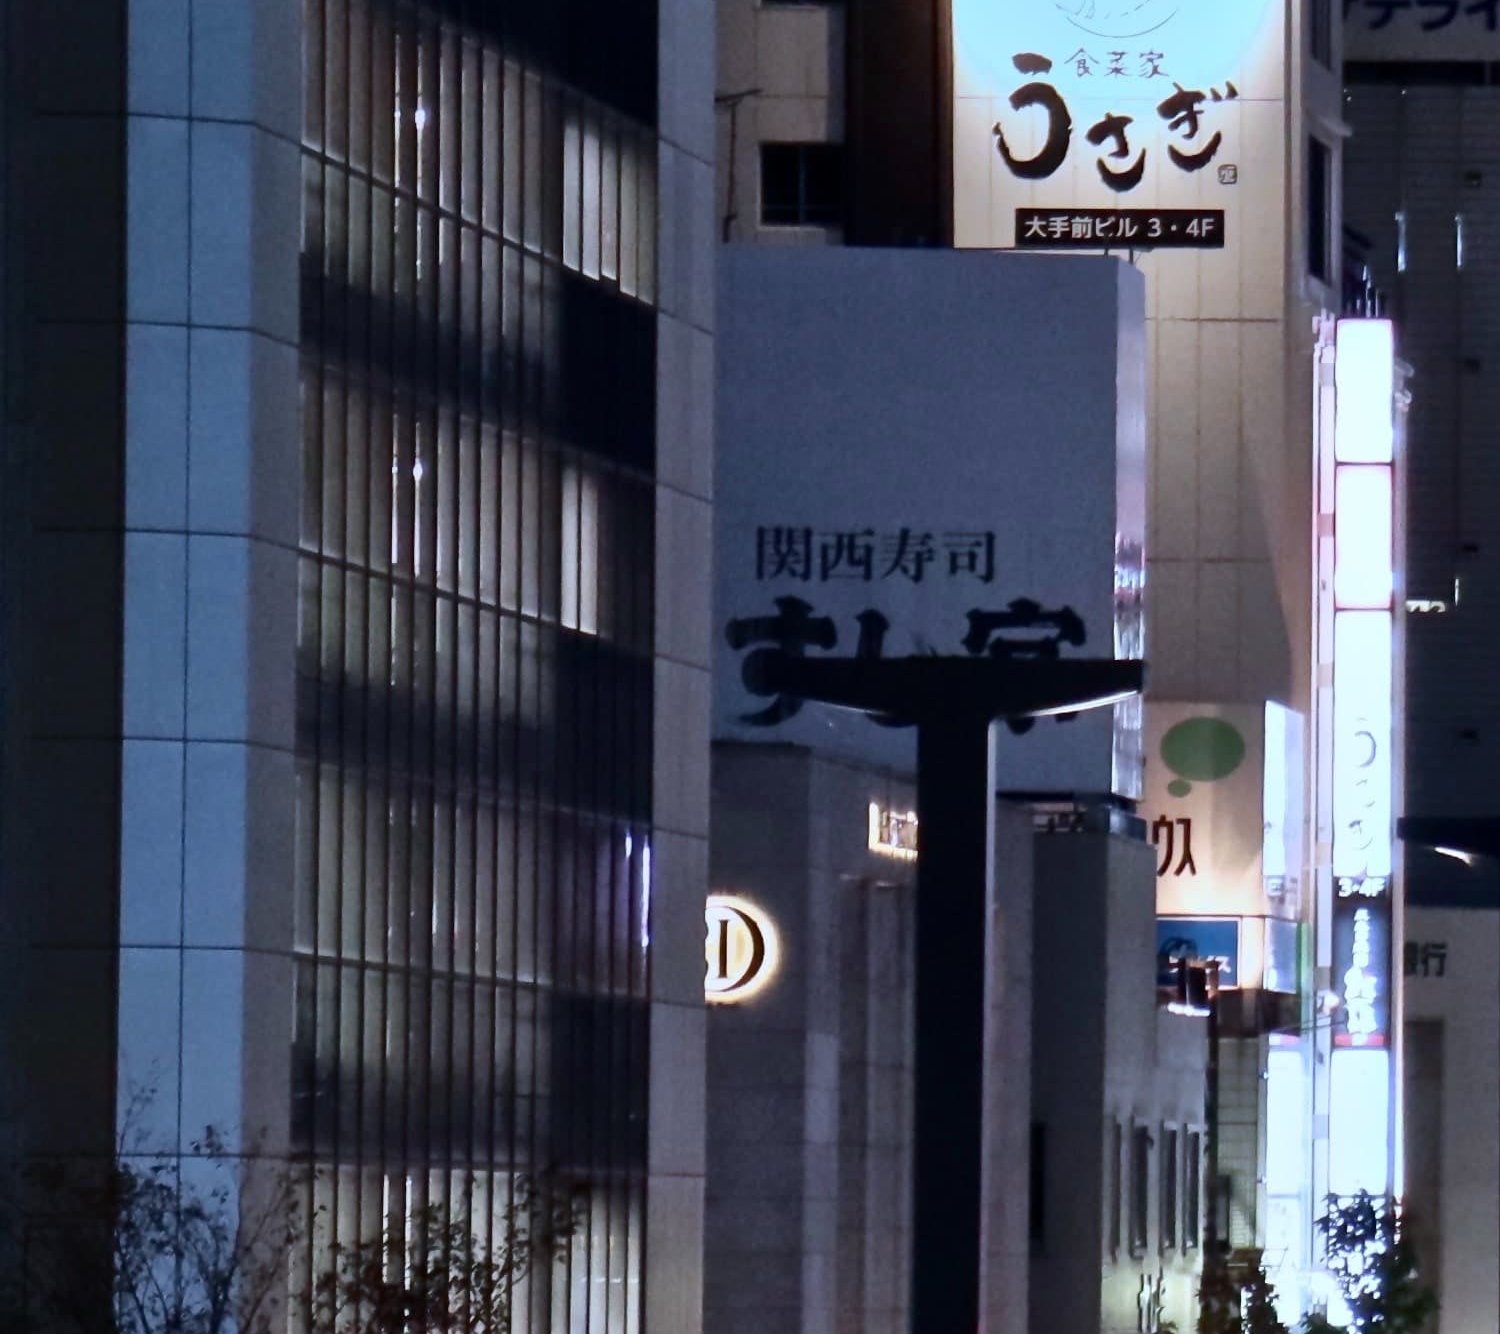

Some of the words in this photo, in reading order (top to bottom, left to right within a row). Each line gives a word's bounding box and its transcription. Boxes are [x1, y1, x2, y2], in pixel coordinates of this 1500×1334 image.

[1063, 48, 1170, 80] 食菜家
[992, 53, 1240, 191] うさぎ
[1024, 216, 1137, 241] 大手前ビル
[755, 525, 997, 584] 関西寿司
